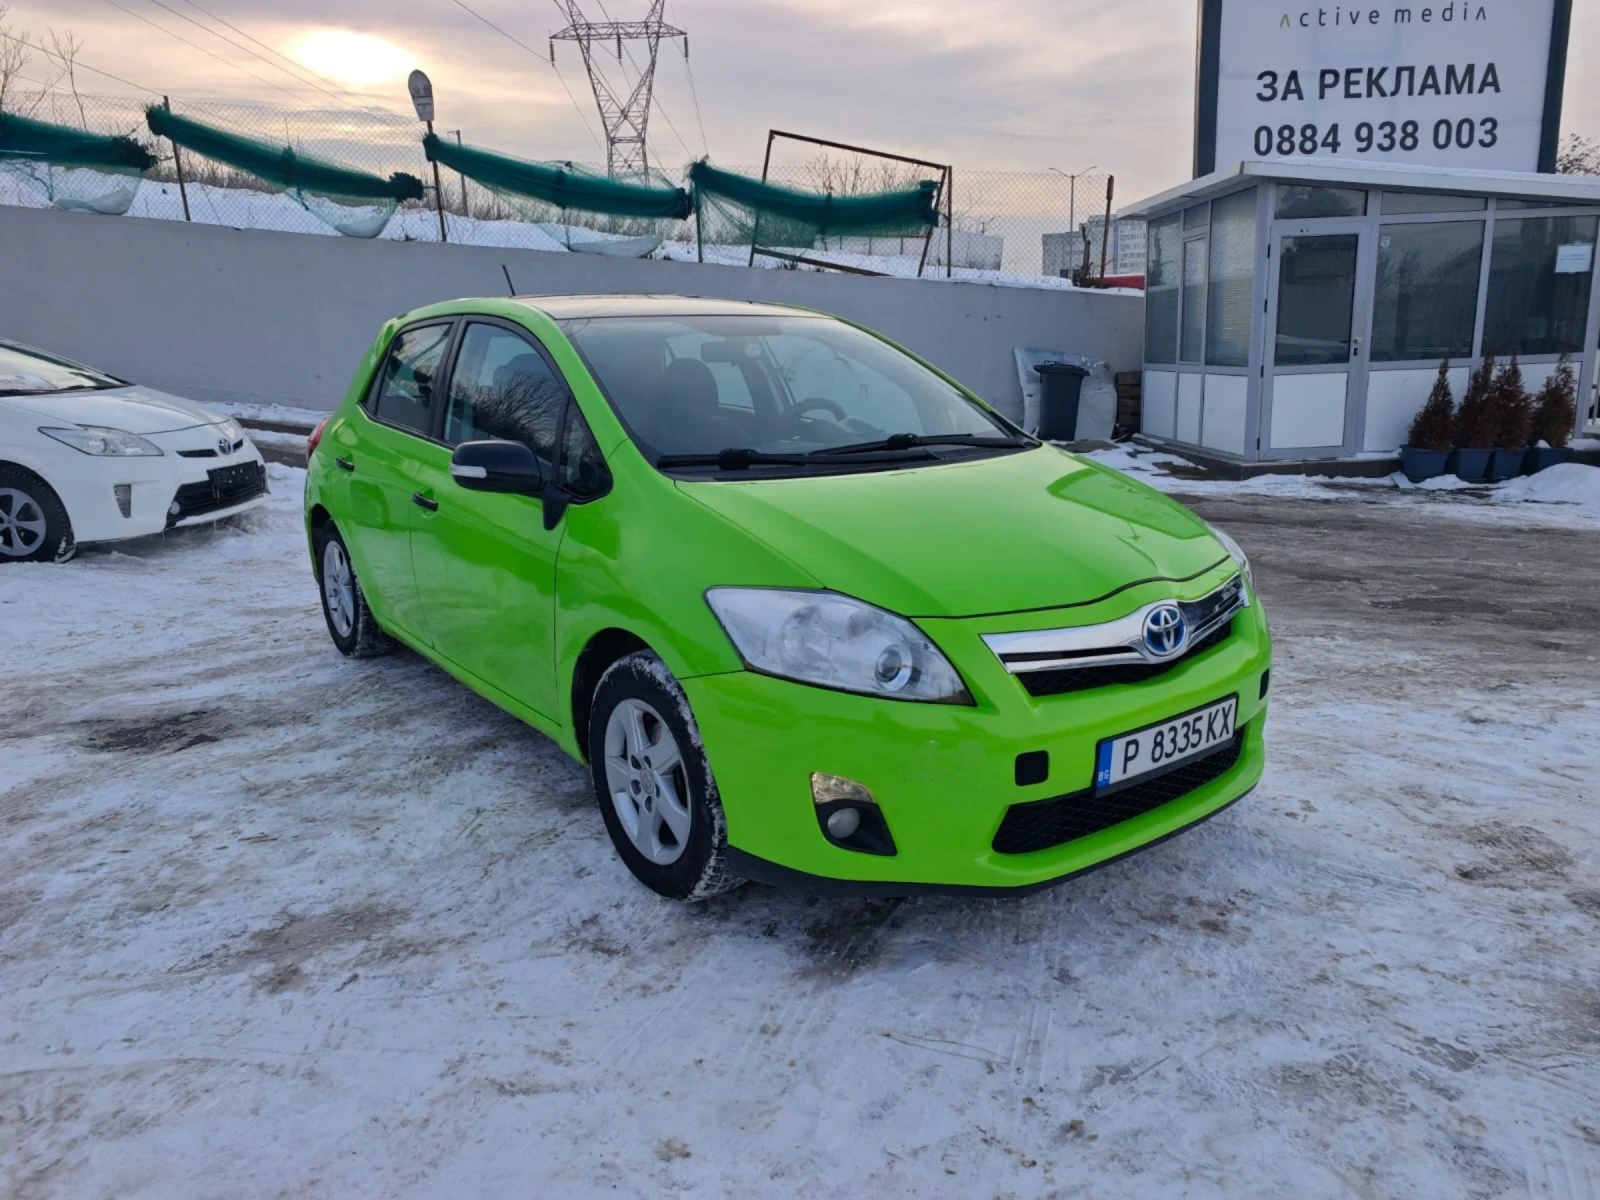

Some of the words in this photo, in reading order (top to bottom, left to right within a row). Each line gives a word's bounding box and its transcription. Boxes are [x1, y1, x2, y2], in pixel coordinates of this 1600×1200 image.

[1255, 70, 1304, 102] ЗА
[1318, 62, 1501, 100] РЕКЛАМА
[1254, 123, 1341, 156] 0884
[1354, 120, 1419, 153] 938
[1432, 117, 1498, 150] 003
